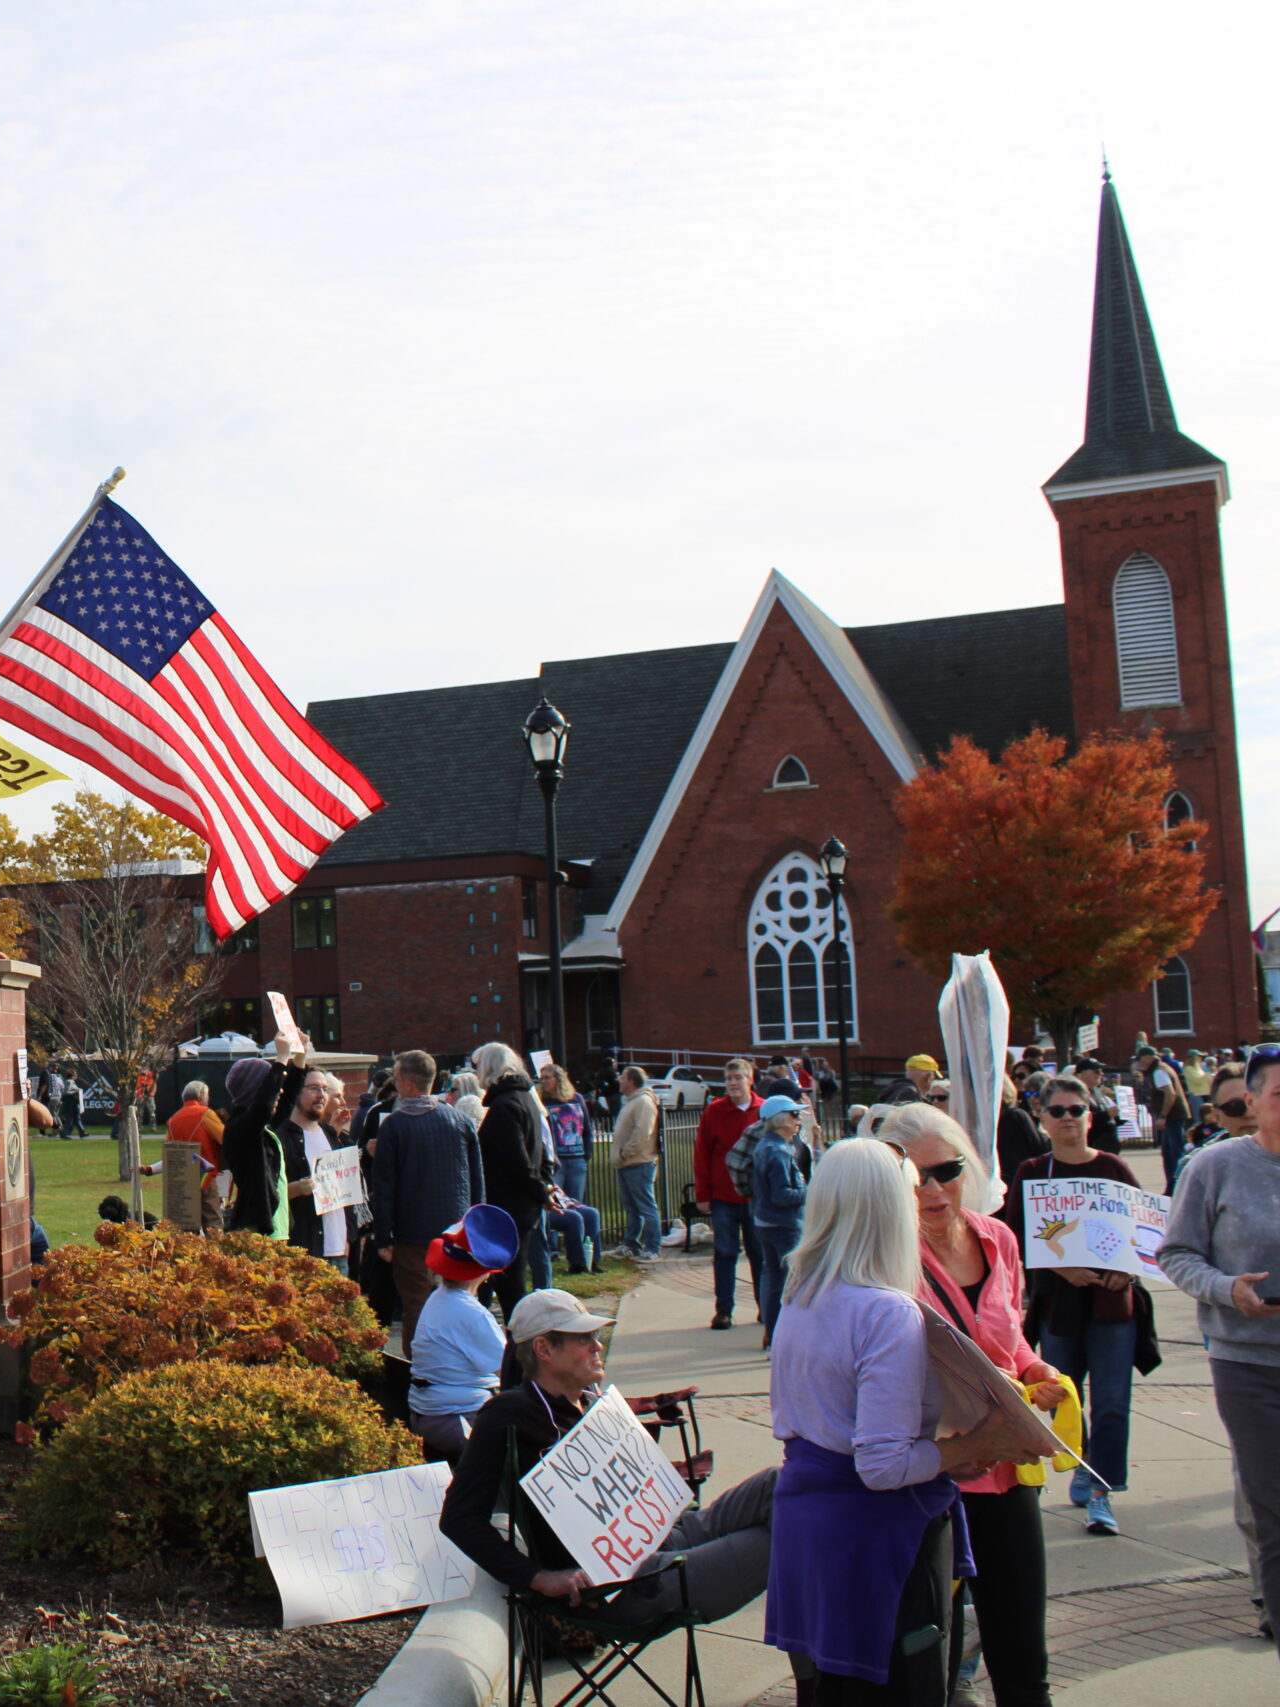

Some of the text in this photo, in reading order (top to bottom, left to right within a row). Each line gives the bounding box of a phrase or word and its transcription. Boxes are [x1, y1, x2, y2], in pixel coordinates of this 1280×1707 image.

[1029, 1195, 1086, 1213] TRUMP
[1088, 1200, 1099, 1212] A
[1100, 1199, 1131, 1217] ROYAL
[1067, 1180, 1108, 1196] TIME
[1113, 1183, 1131, 1201] TO
[1135, 1190, 1168, 1213] DEAL
[526, 1468, 555, 1513] IF
[548, 1429, 598, 1490] NOT
[575, 1426, 655, 1525] WHEN??
[319, 1556, 471, 1619] RUSSIA
